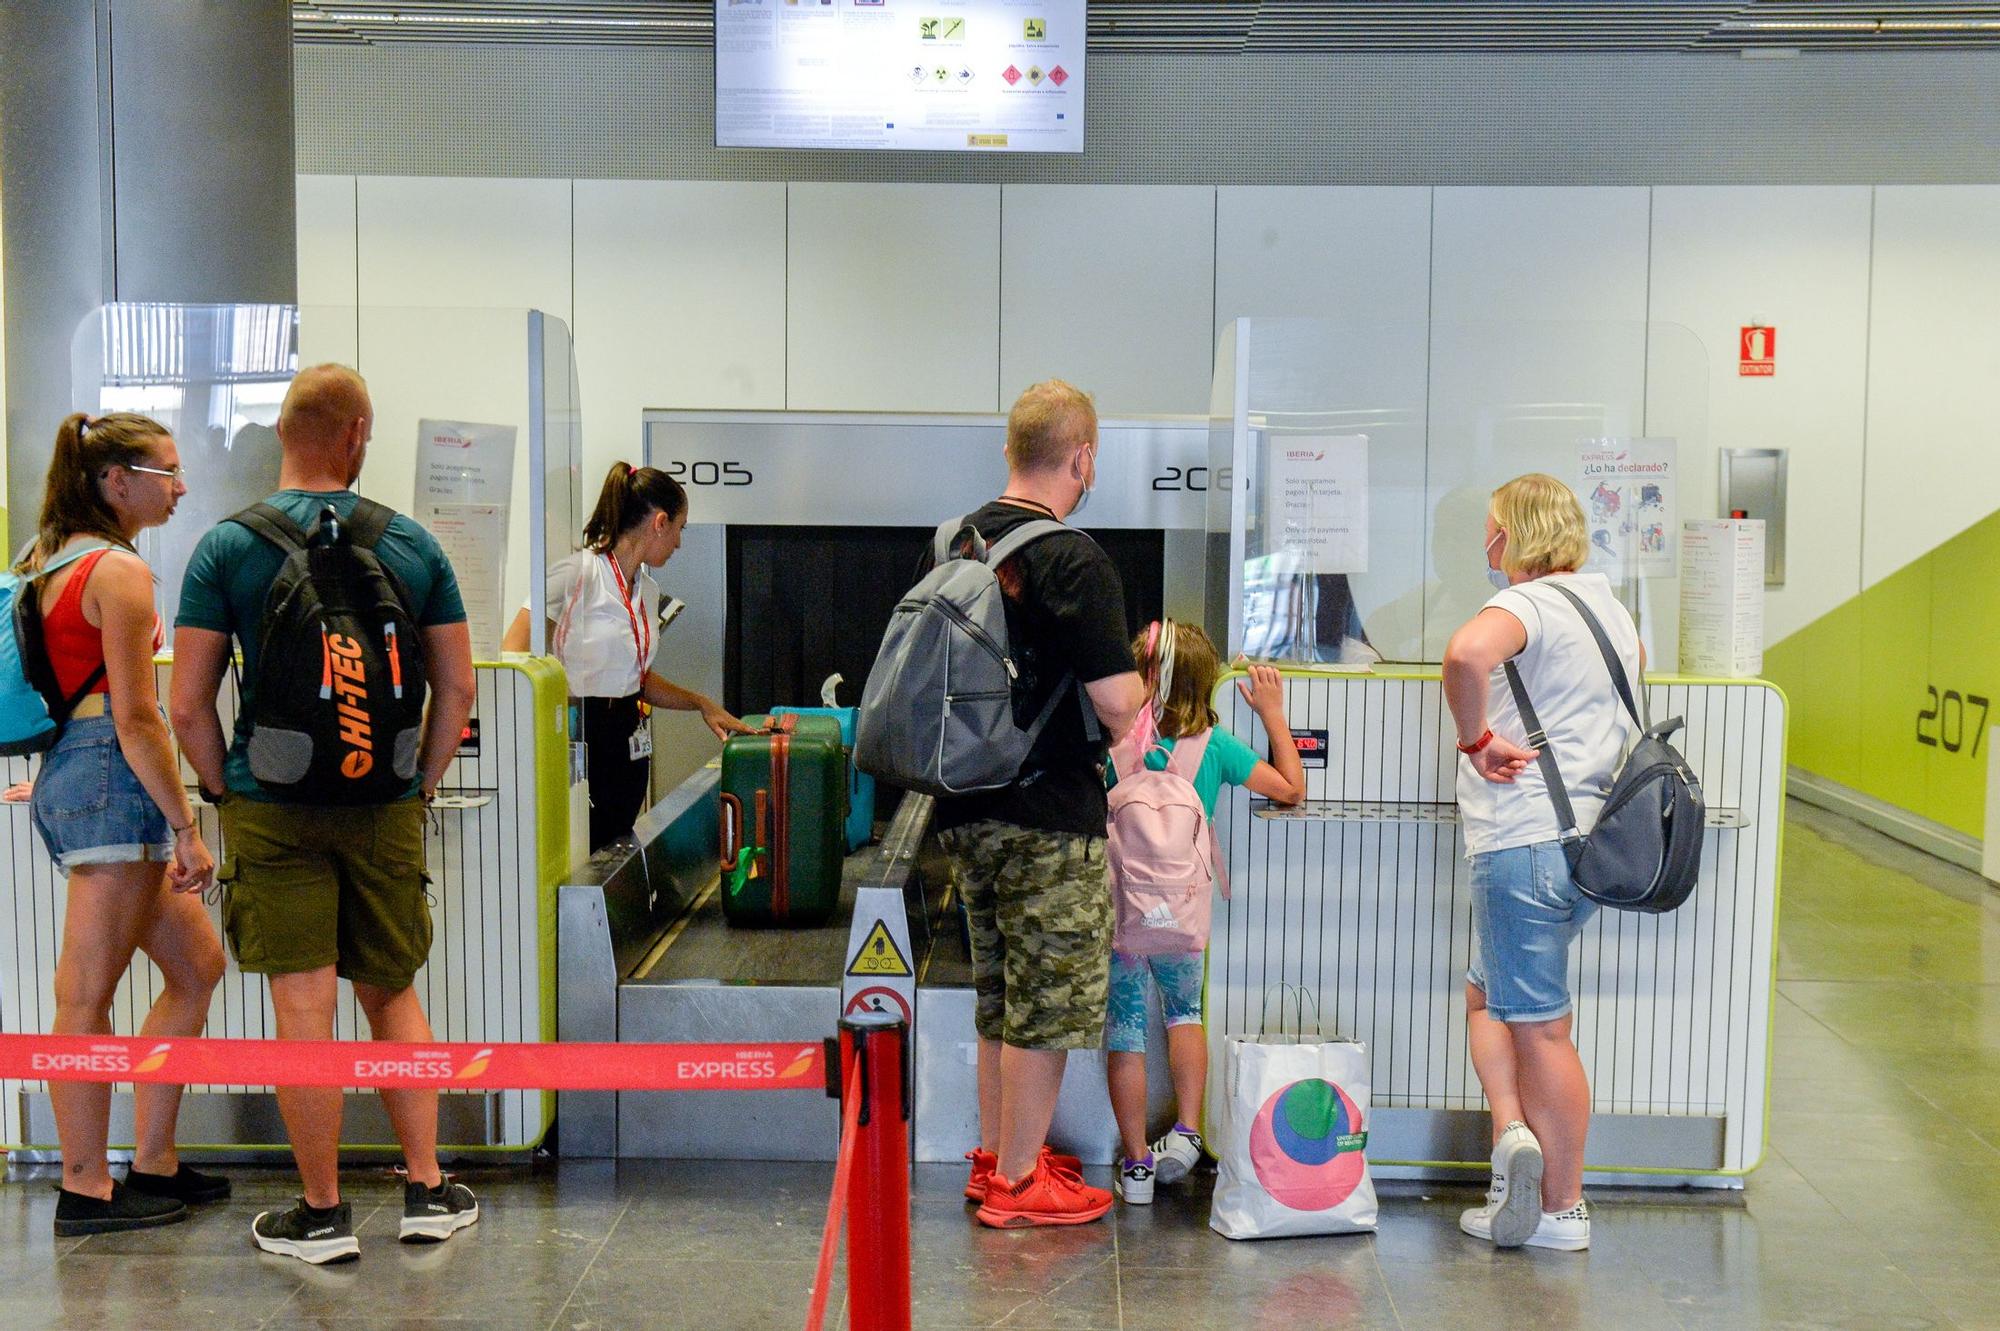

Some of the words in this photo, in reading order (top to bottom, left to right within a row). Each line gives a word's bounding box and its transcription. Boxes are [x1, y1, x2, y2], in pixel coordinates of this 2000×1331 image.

[1286, 450, 1314, 458] IBERIA
[665, 461, 753, 486] 205
[1584, 463, 1602, 475] ¿Lo
[1604, 463, 1616, 473] ha
[1617, 462, 1669, 473] declarado?
[328, 633, 373, 750] HI-TEC
[1917, 684, 1990, 759] 207
[1140, 917, 1179, 928] adidas
[31, 1053, 131, 1073] EXPRESS
[354, 1060, 453, 1079] EXPRESS
[677, 1061, 776, 1080] EXPRESS
